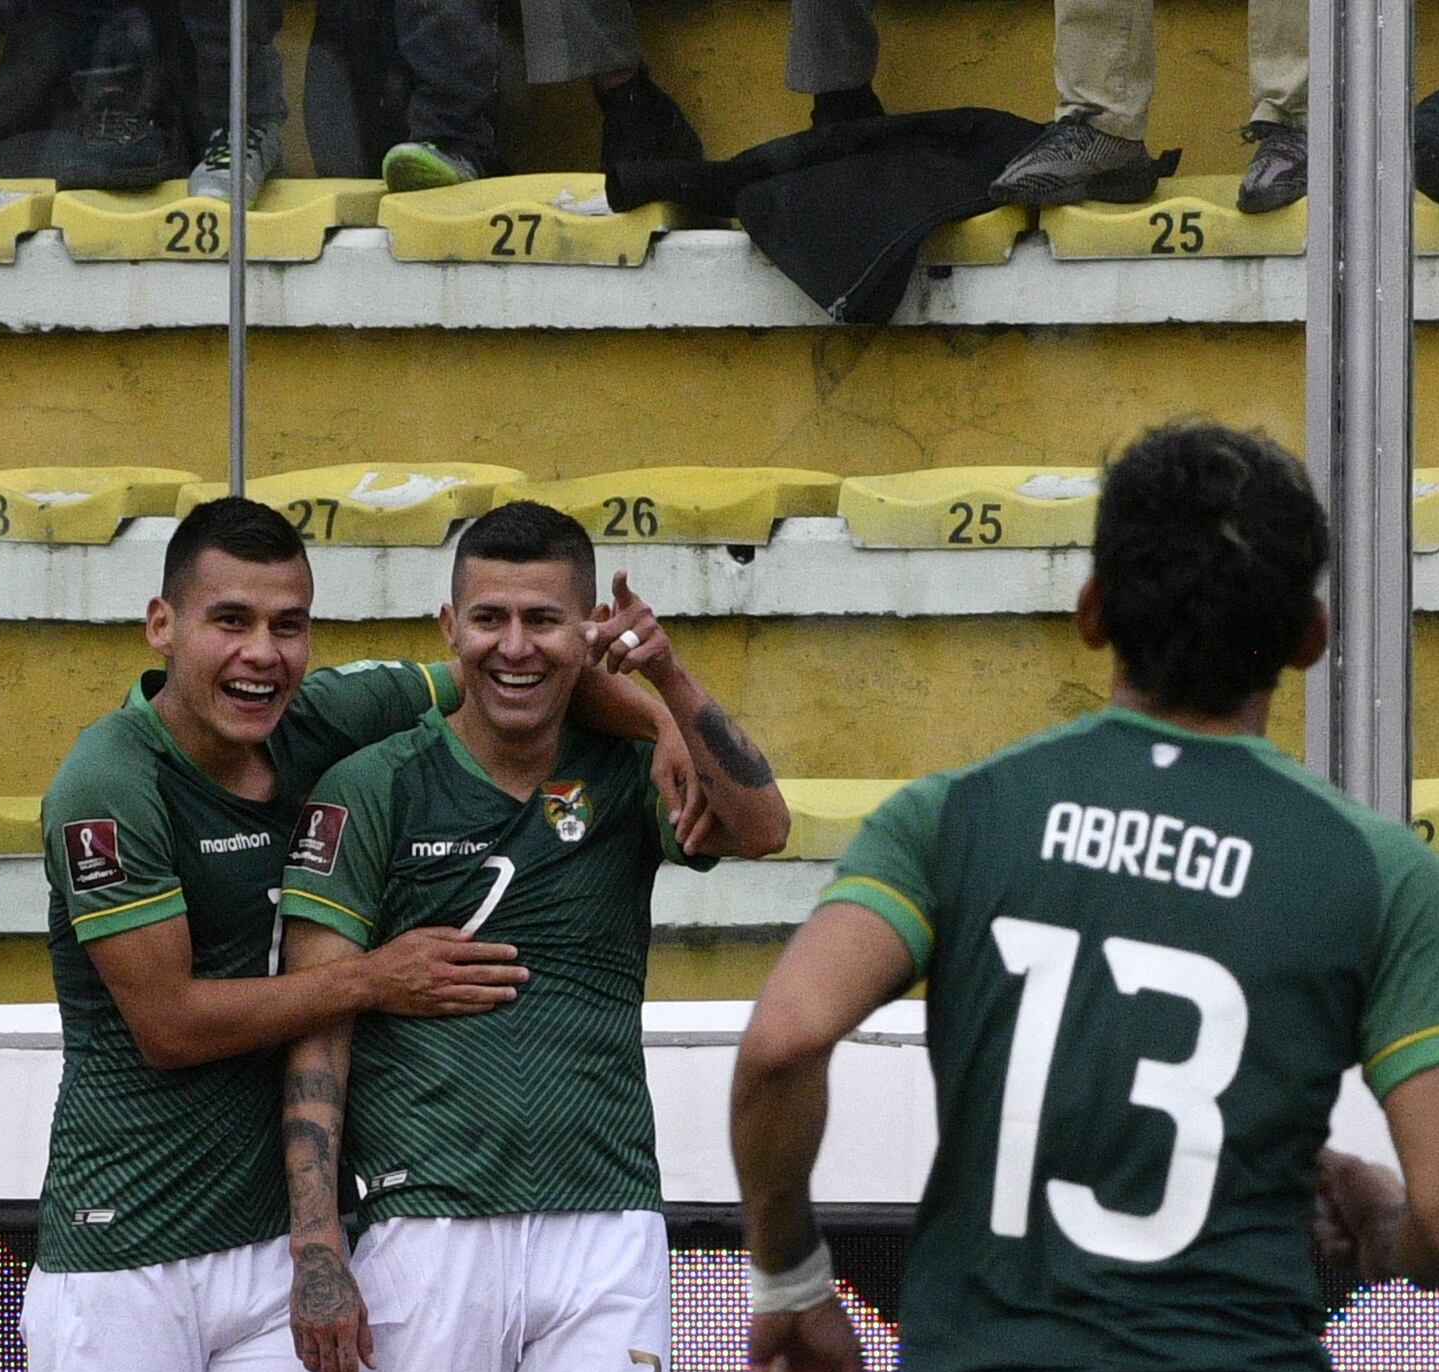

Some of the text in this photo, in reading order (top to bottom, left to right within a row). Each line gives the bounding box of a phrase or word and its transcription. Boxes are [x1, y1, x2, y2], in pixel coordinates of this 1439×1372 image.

[165, 211, 219, 254] 28
[490, 215, 541, 256] 27
[1150, 212, 1203, 254] 25
[290, 500, 338, 541] 27
[603, 497, 658, 539] 26
[948, 503, 1002, 545] 25
[200, 832, 271, 853] marathon
[412, 839, 499, 856] maratho
[1041, 802, 1252, 898] ABREGO
[459, 855, 516, 934] 7
[991, 916, 1249, 1263] 13
